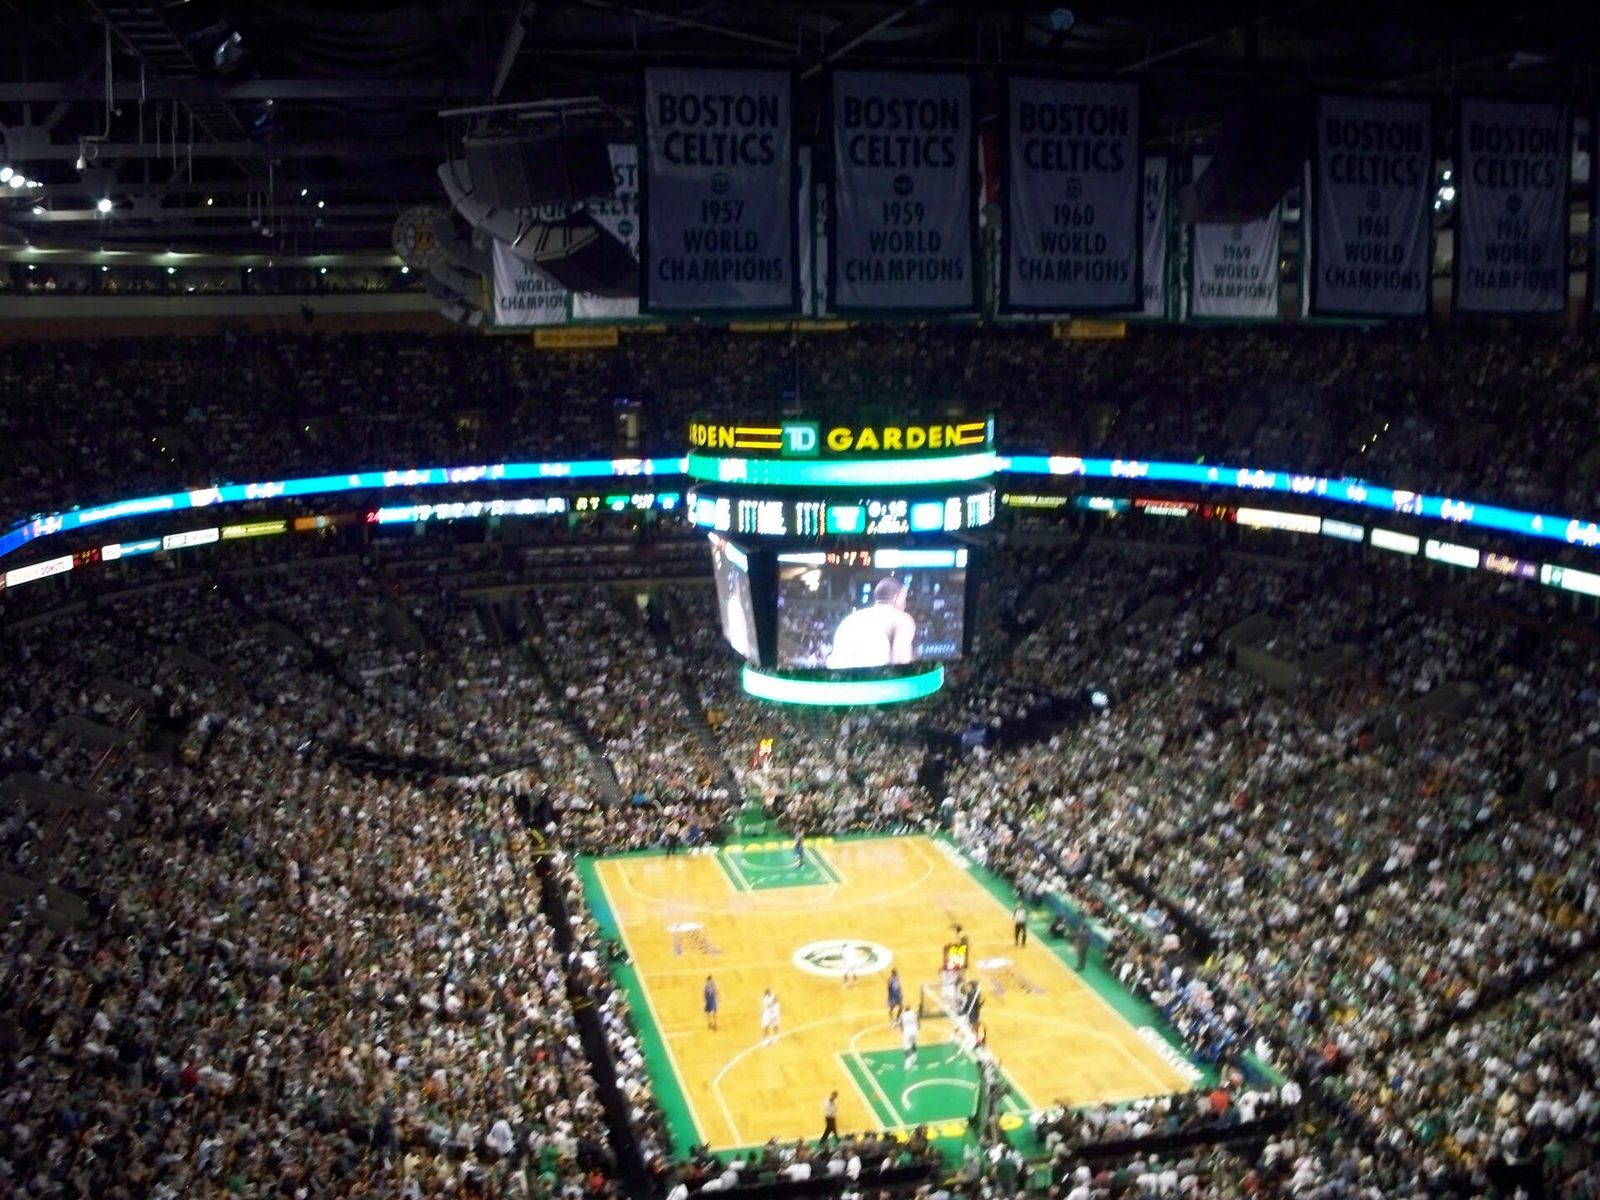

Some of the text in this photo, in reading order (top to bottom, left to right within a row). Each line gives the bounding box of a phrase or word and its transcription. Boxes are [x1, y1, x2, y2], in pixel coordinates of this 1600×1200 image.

[659, 91, 778, 127] BOSTON
[844, 96, 960, 131] BOSTON
[1020, 103, 1128, 136] BOSTON
[1326, 118, 1422, 151] BOSTON
[1470, 123, 1559, 155] BOSTON
[664, 131, 775, 165] CELTICS
[849, 135, 956, 168] CELTICS
[1024, 141, 1124, 172] CELTICS
[1331, 154, 1419, 186] CELTICS
[1473, 158, 1554, 189] CELTICS
[701, 199, 745, 224] 1957
[882, 201, 925, 225] 1959
[1053, 203, 1094, 227] 1960
[1358, 216, 1389, 237] 1961
[684, 227, 759, 252] WORLD
[868, 229, 941, 254] WORLD
[1041, 231, 1106, 255] WORLD
[1345, 241, 1405, 264] WORLD
[1486, 242, 1542, 264] WORLD
[658, 257, 784, 283] CHAMPIONS
[845, 258, 964, 282] CHAMPIONS
[1018, 258, 1128, 282] CHAMPIONS
[1214, 263, 1260, 280] WORLD
[1326, 264, 1421, 290] CHAMPIONS
[1200, 281, 1273, 299] CHAMPIONS
[786, 425, 961, 452] TD GARDEN
